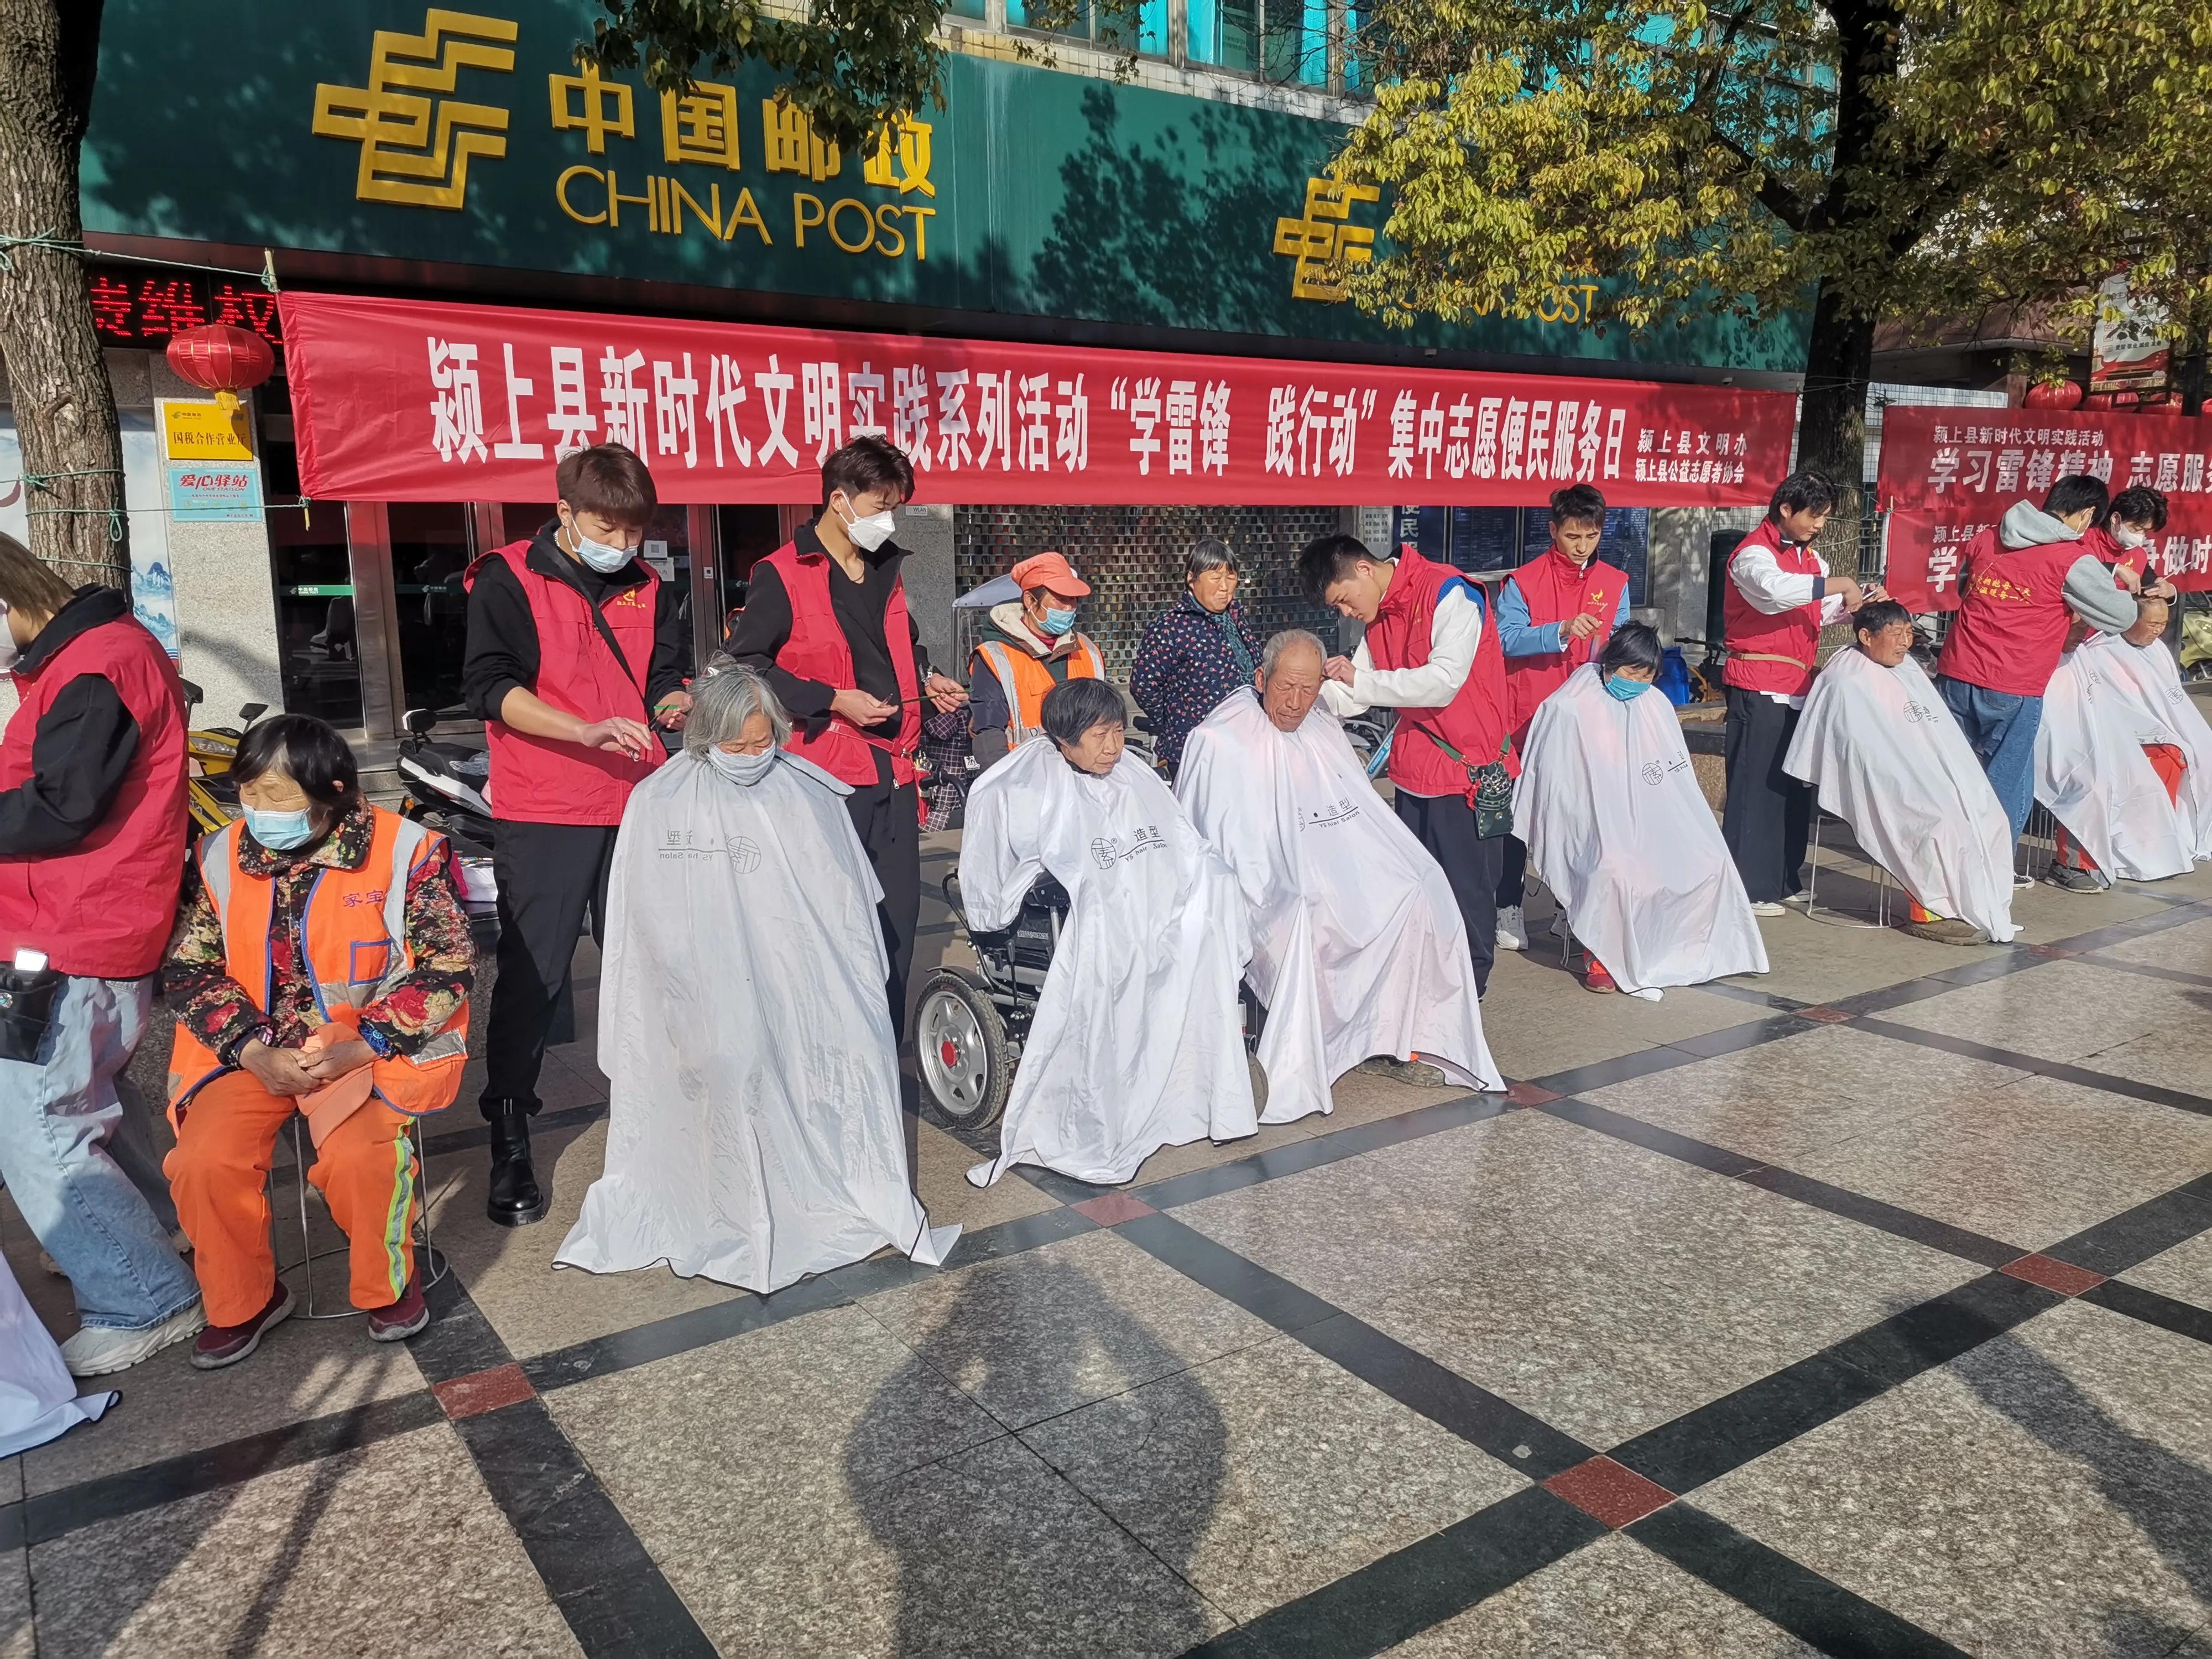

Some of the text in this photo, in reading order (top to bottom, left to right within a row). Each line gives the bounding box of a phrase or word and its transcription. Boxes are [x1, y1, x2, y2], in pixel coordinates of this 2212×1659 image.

[549, 58, 936, 198] 中国邮政
[556, 165, 936, 260] CHINA POST
[1537, 282, 1599, 324] OST
[173, 431, 246, 445] 国税合作营业厅
[1388, 389, 1626, 483] 集中志愿便民服务日
[179, 474, 248, 489] 爱心驿站
[1927, 447, 2212, 494] 学习雷锋精神 志愿服
[1133, 825, 1161, 843] 造型
[1340, 811, 1360, 823] Salon
